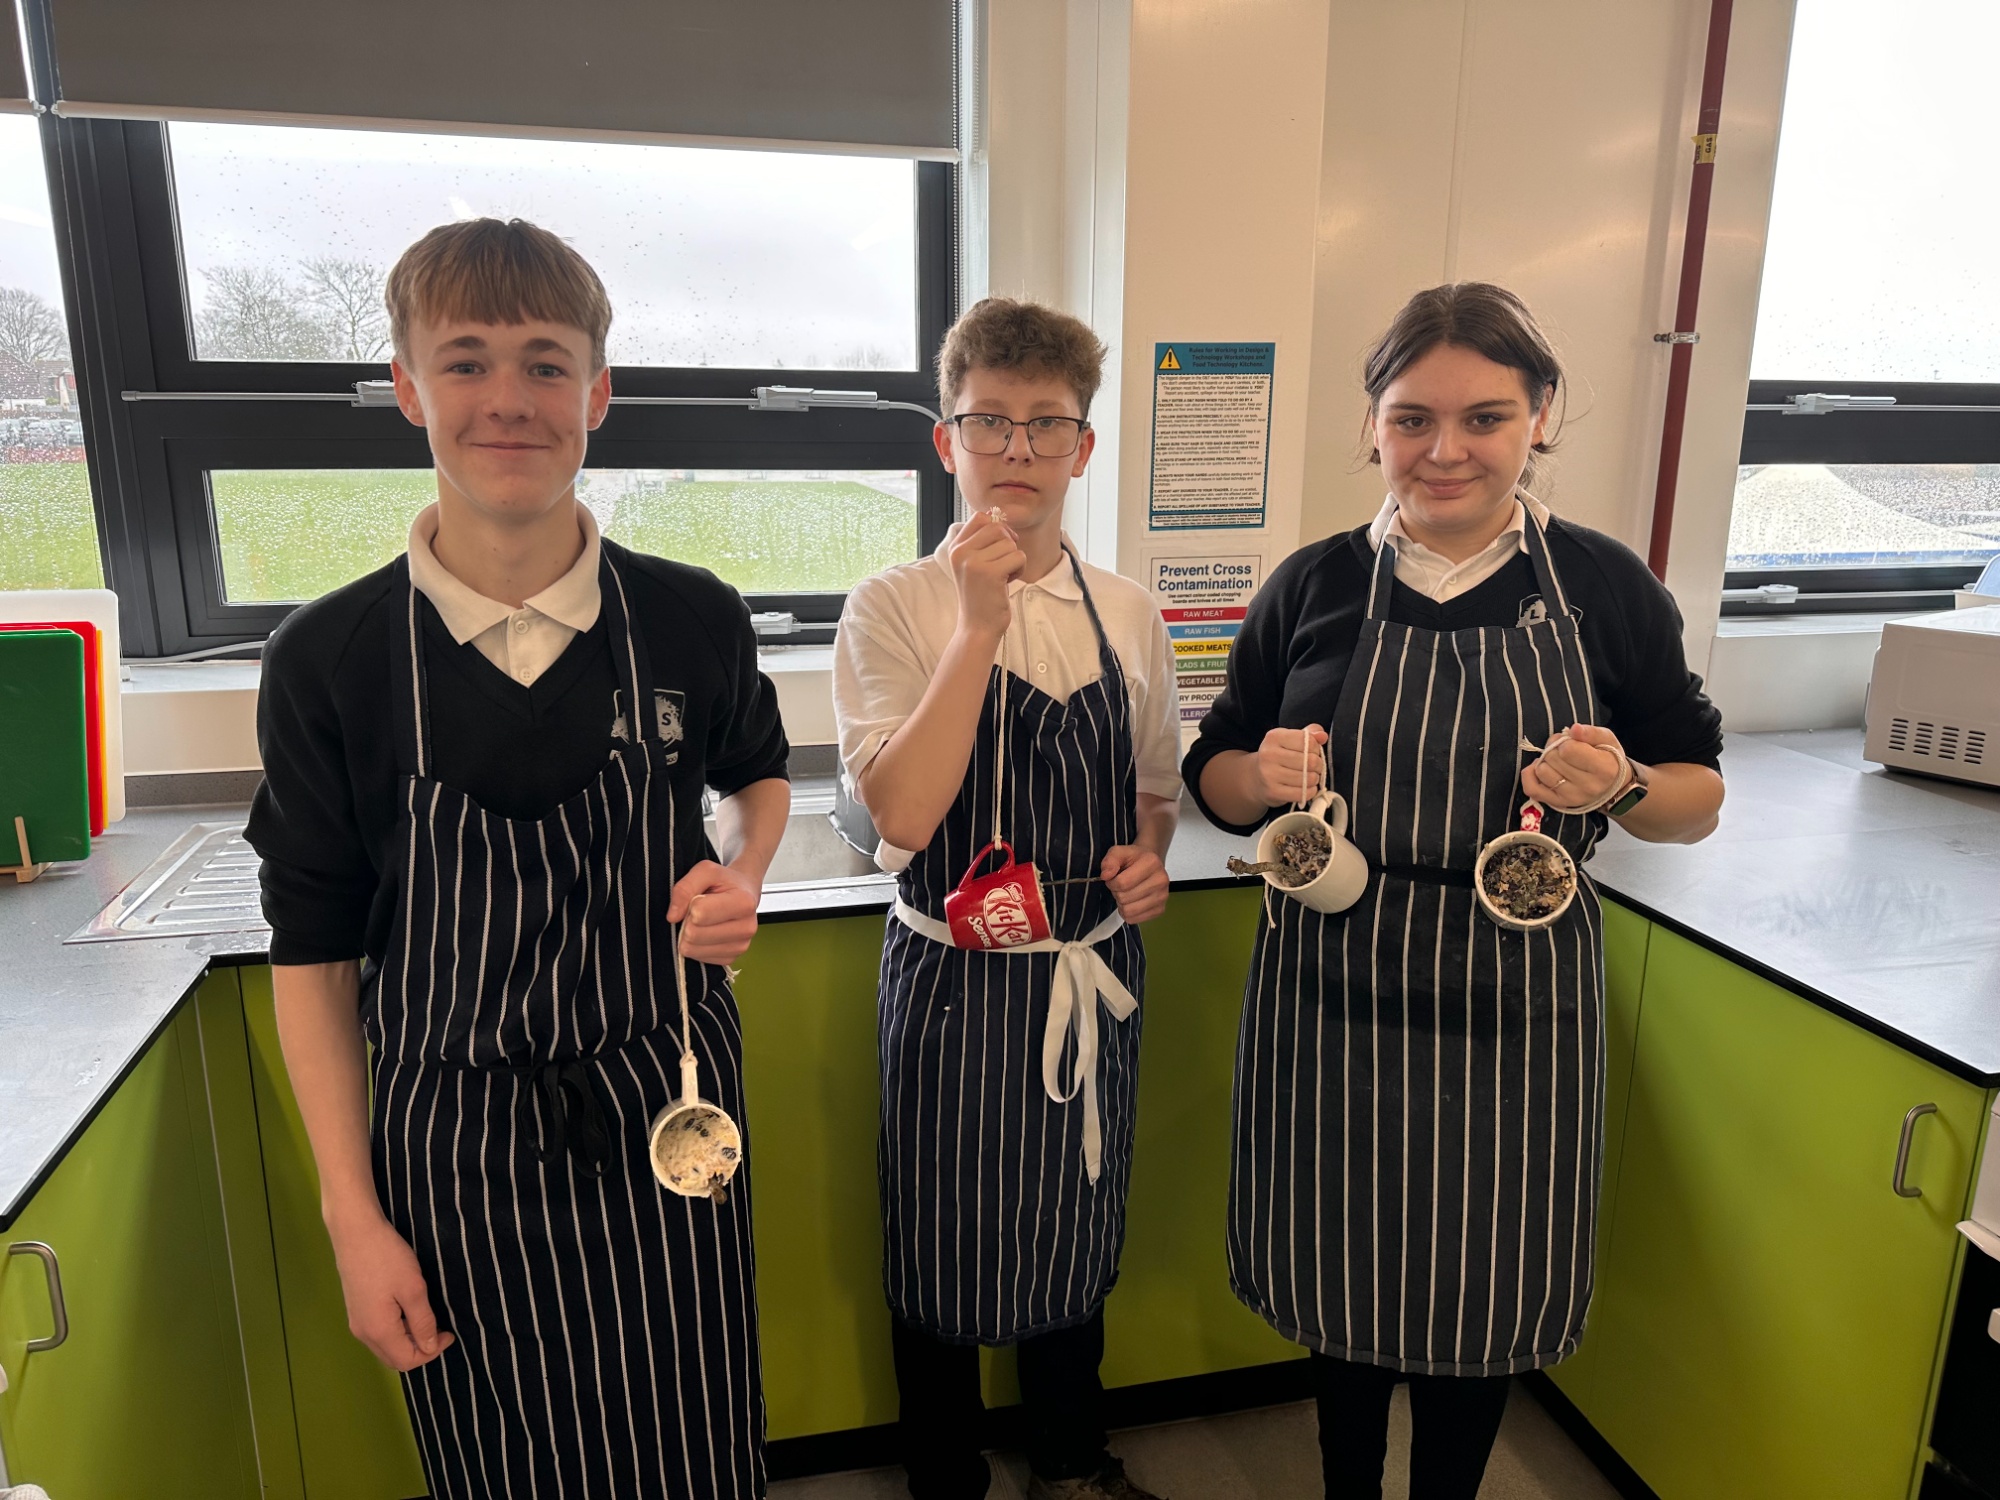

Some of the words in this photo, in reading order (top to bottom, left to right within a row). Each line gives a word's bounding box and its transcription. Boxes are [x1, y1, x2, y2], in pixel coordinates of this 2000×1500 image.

[1705, 137, 1713, 154] GAS
[1160, 565, 1209, 576] Prevent
[1213, 564, 1252, 574] Cross
[1158, 578, 1252, 591] Contamination
[662, 712, 672, 726] S
